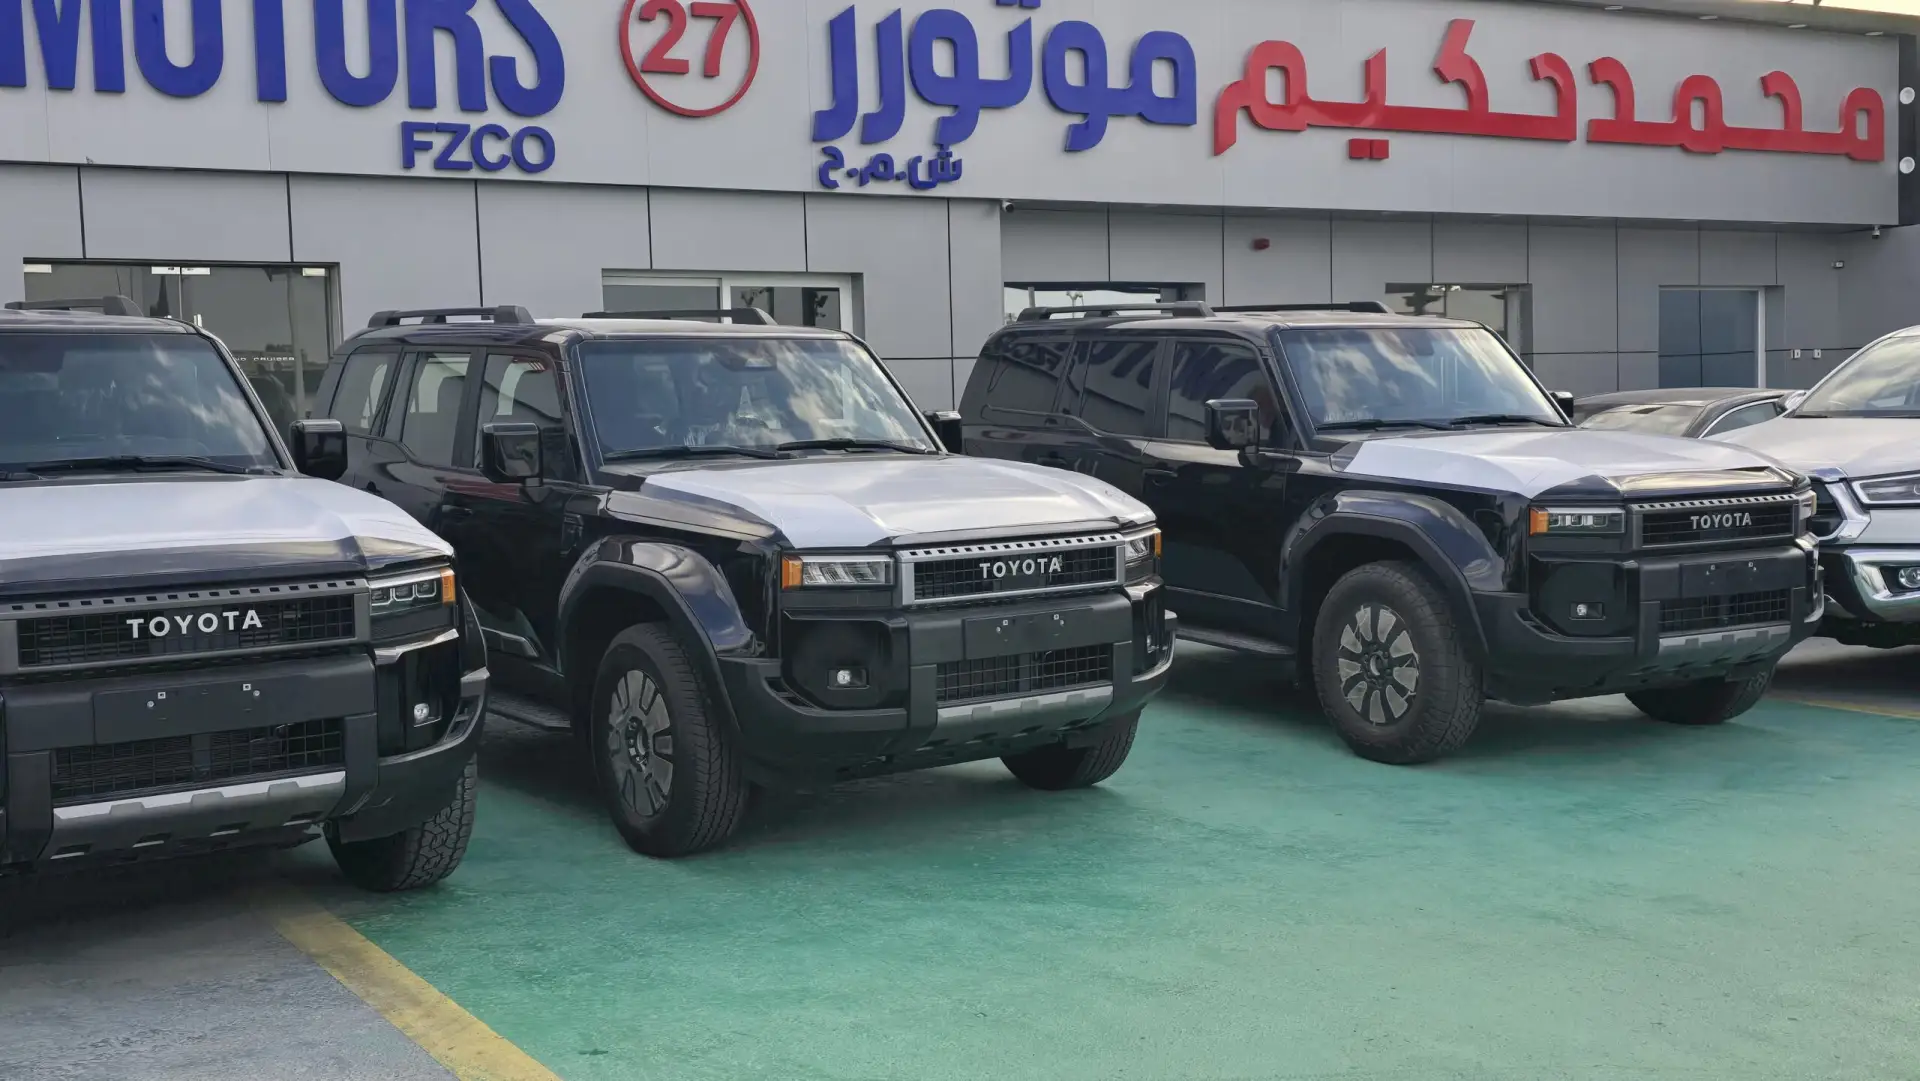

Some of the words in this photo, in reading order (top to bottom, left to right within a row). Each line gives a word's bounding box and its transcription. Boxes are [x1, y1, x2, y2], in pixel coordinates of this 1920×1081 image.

[639, 0, 740, 77] 27
[1213, 19, 1577, 160] حكيم
[1586, 56, 1885, 161] محمد
[401, 121, 556, 173] FZCO
[1691, 512, 1752, 530] TOYOTA
[980, 557, 1061, 579] TOYOTA
[126, 609, 262, 639] TOYOTA
